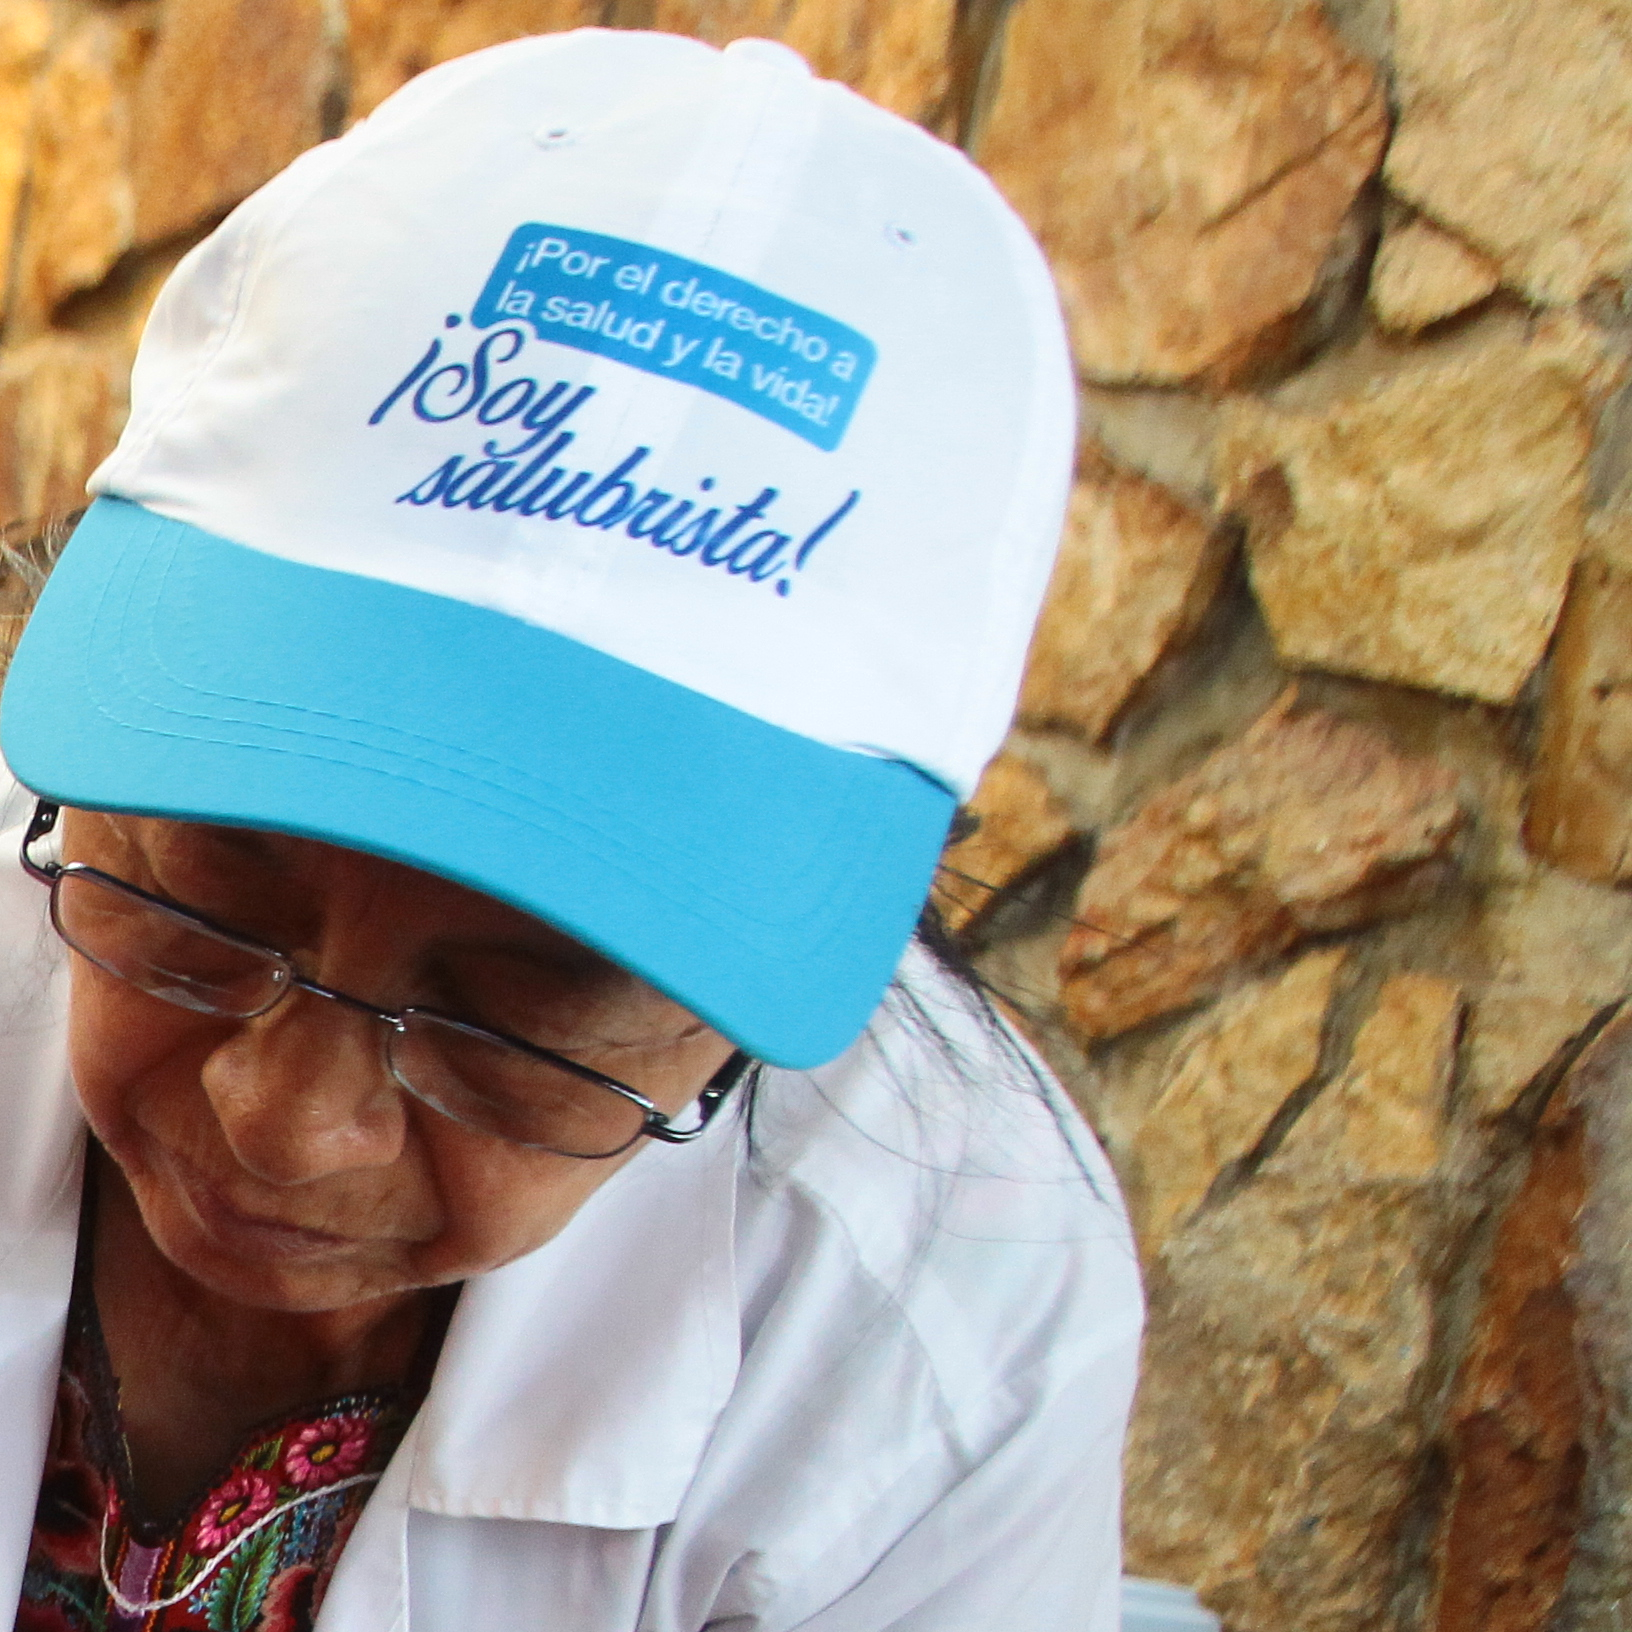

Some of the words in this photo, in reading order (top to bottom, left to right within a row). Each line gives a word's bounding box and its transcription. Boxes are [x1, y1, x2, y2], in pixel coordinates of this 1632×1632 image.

[496, 280, 535, 317] la
[540, 296, 667, 351] salud
[661, 333, 703, 368] y
[702, 337, 743, 380] la
[751, 364, 841, 427] vida!
[514, 237, 611, 279] ¡Por
[613, 262, 659, 295] el
[660, 278, 829, 363] derecho
[830, 351, 857, 382] a
[368, 313, 597, 458] ¡Soy
[394, 430, 861, 598] salubrista!
